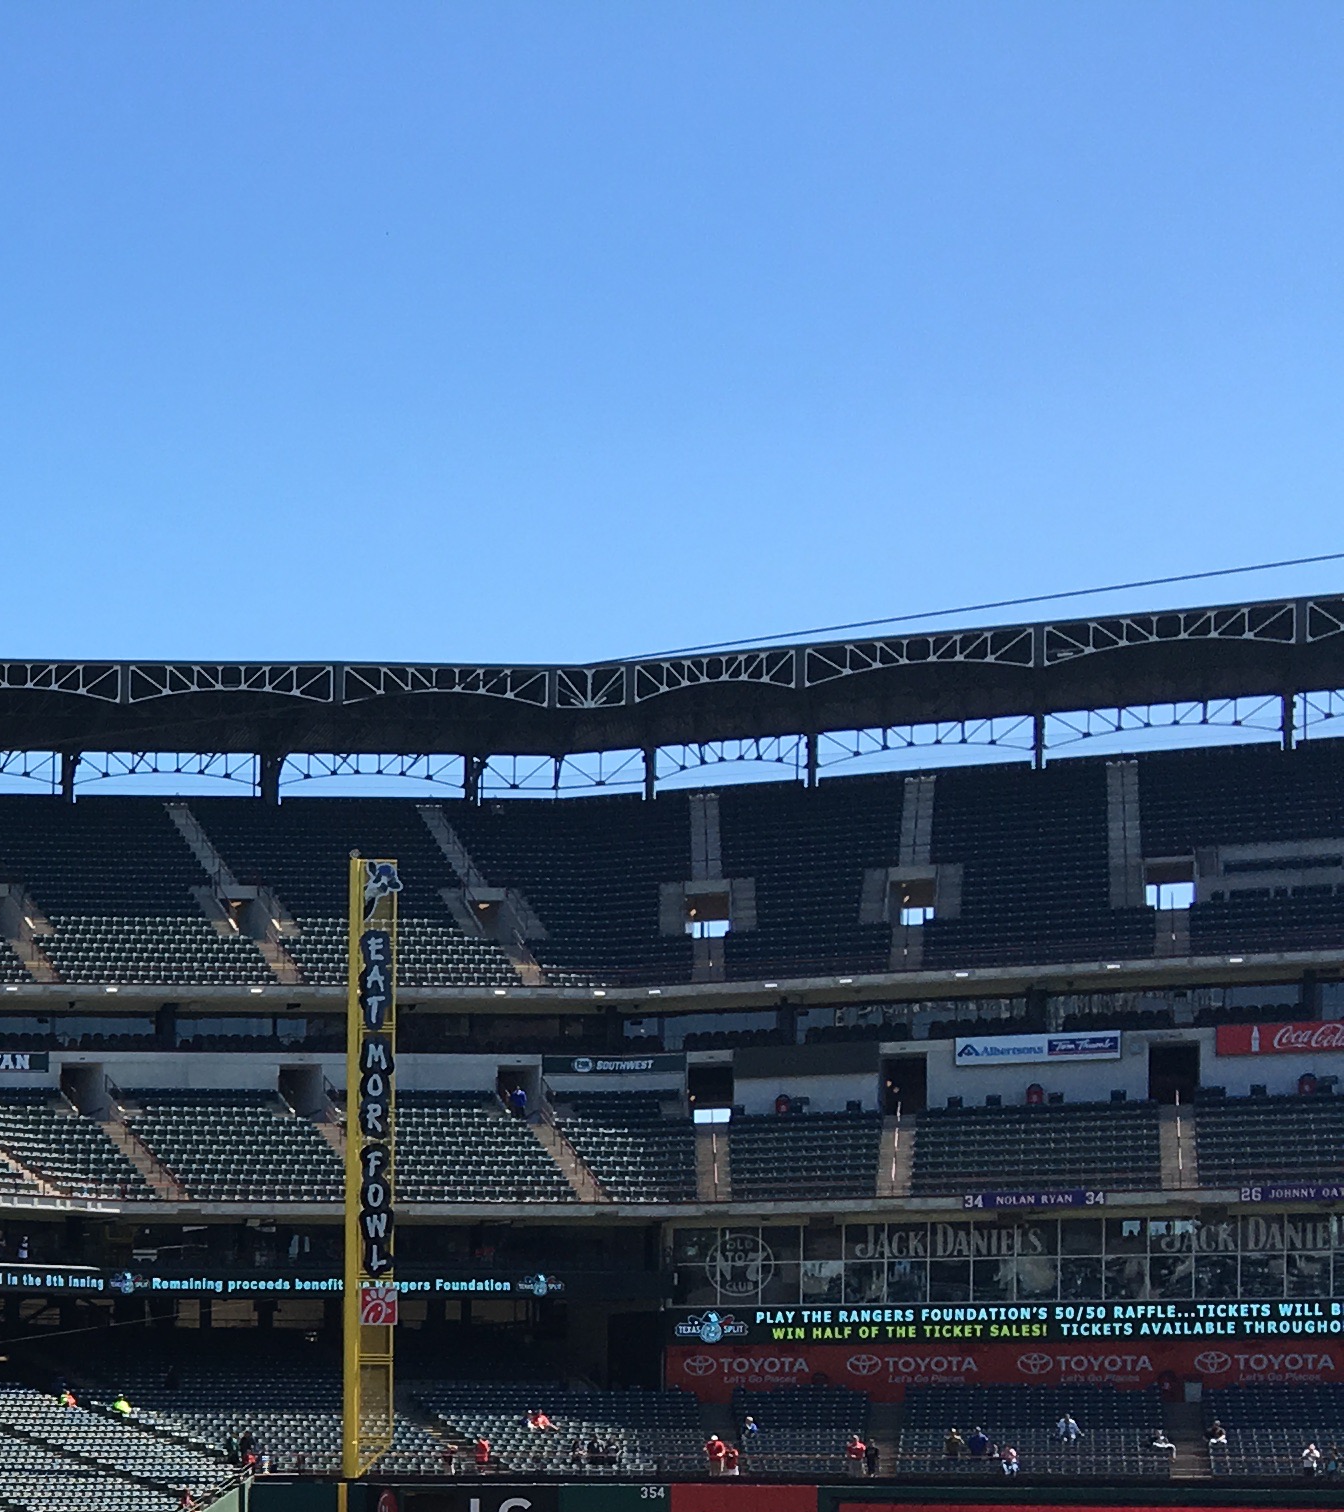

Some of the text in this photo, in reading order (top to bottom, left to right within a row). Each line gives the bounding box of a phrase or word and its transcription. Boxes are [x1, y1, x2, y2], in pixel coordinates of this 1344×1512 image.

[366, 936, 386, 1025] EAT
[981, 1045, 1044, 1056] Albertsons
[596, 1060, 654, 1071] SOUTHWEST
[366, 1043, 388, 1133] MOR
[965, 1192, 1105, 1209] 34 NOLAN RYAN 34
[1241, 1187, 1317, 1201] 26 JOHNNY
[366, 1150, 387, 1272] FOWL
[855, 1227, 927, 1259] JACK
[1160, 1221, 1233, 1252] JACK
[7, 1273, 18, 1286] in
[23, 1273, 42, 1287] the
[68, 1275, 104, 1290] inning
[152, 1278, 223, 1292] Remaining
[227, 1278, 291, 1293] proceeds
[295, 1277, 344, 1291] benefit
[435, 1278, 511, 1292] Foundation
[755, 1310, 796, 1324] PLAY
[802, 1310, 833, 1323] THE
[838, 1309, 914, 1323] RANGERS
[921, 1306, 1048, 1322] FOUNDATION'S
[1054, 1306, 1107, 1321] 50/50
[1278, 1303, 1324, 1317] WILL
[679, 1325, 744, 1335] TEXAS SPLIT
[772, 1320, 1344, 1340] WIN HALF OF THE TICKET SALES! TICKETS AVAILABLE THROUGHO
[719, 1357, 810, 1374] TOYOTA
[884, 1355, 979, 1372] TOYOTA
[1056, 1355, 1154, 1372] TOYOTA
[1234, 1353, 1336, 1370] TOYOTA
[640, 1487, 665, 1499] 354
